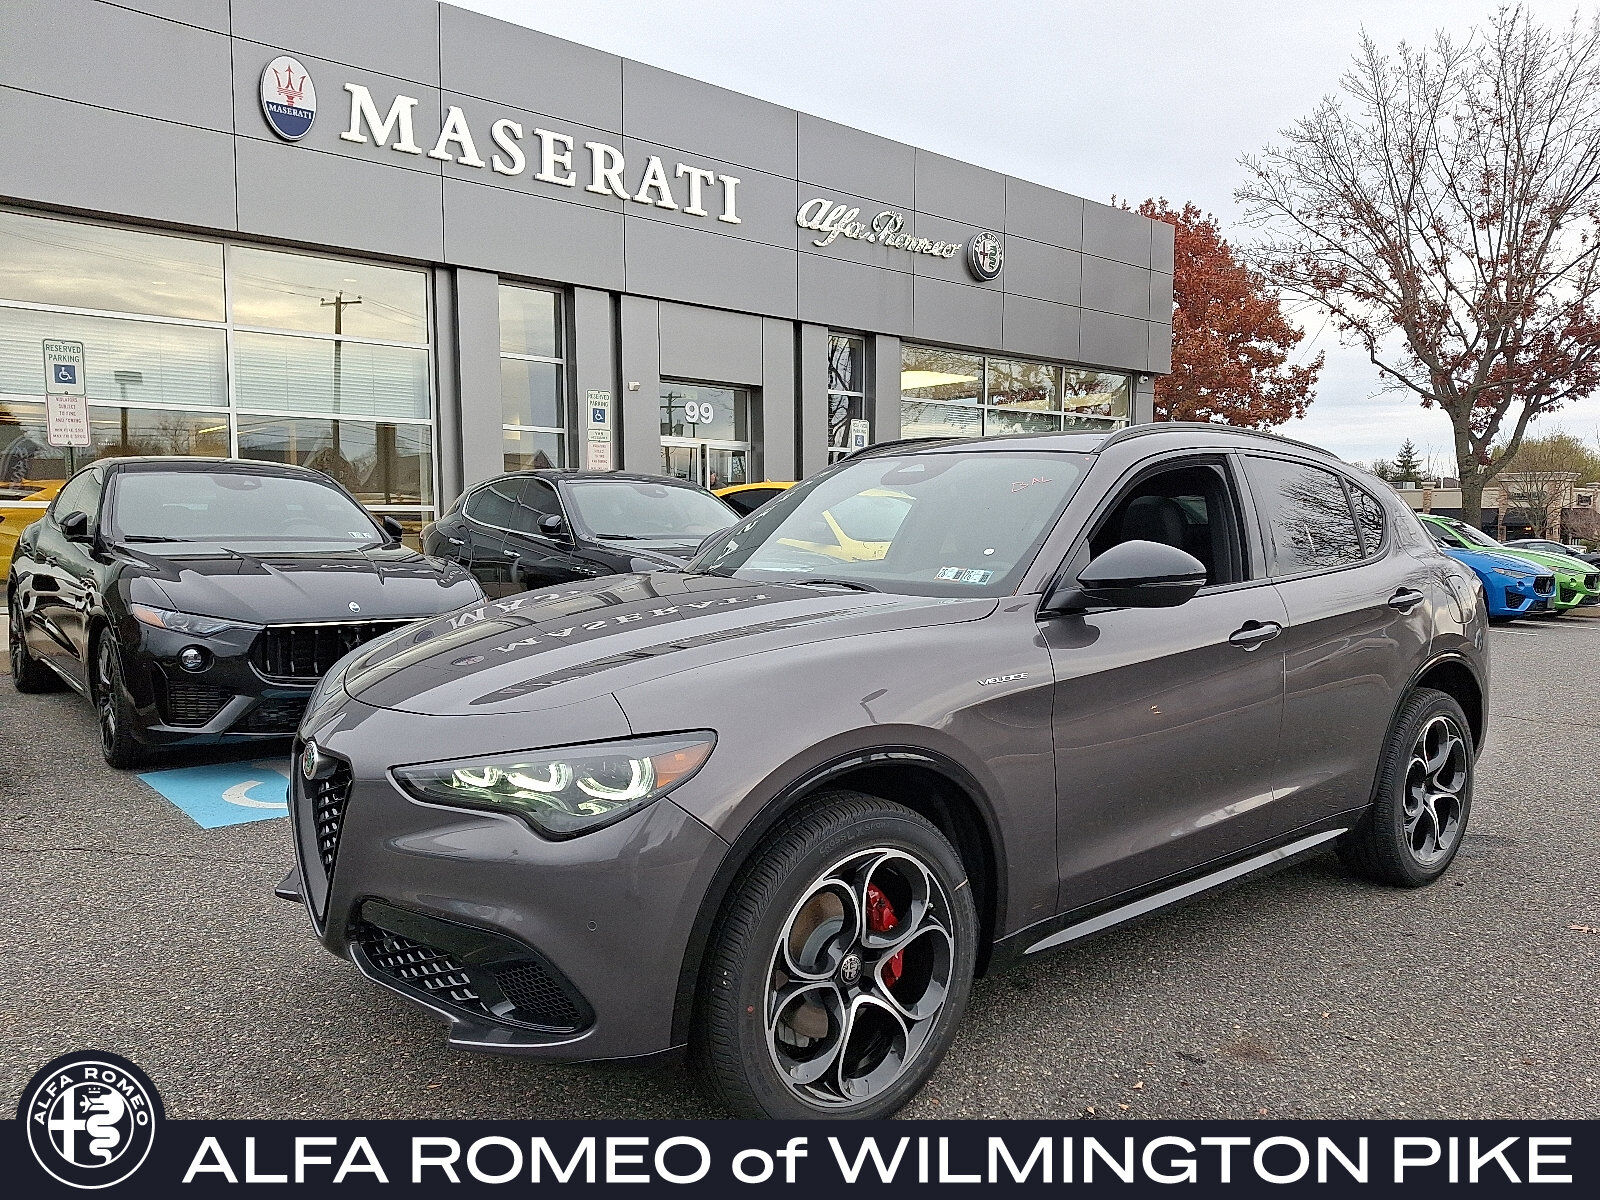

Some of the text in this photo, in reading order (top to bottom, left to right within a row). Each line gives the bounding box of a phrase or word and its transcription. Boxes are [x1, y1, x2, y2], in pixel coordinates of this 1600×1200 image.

[269, 103, 312, 120] MASERATI
[340, 82, 742, 224] MASERATI
[796, 198, 963, 258] Alfa Romeo
[45, 344, 81, 354] RESERVED
[48, 353, 80, 363] PARKING
[685, 401, 714, 424] 99
